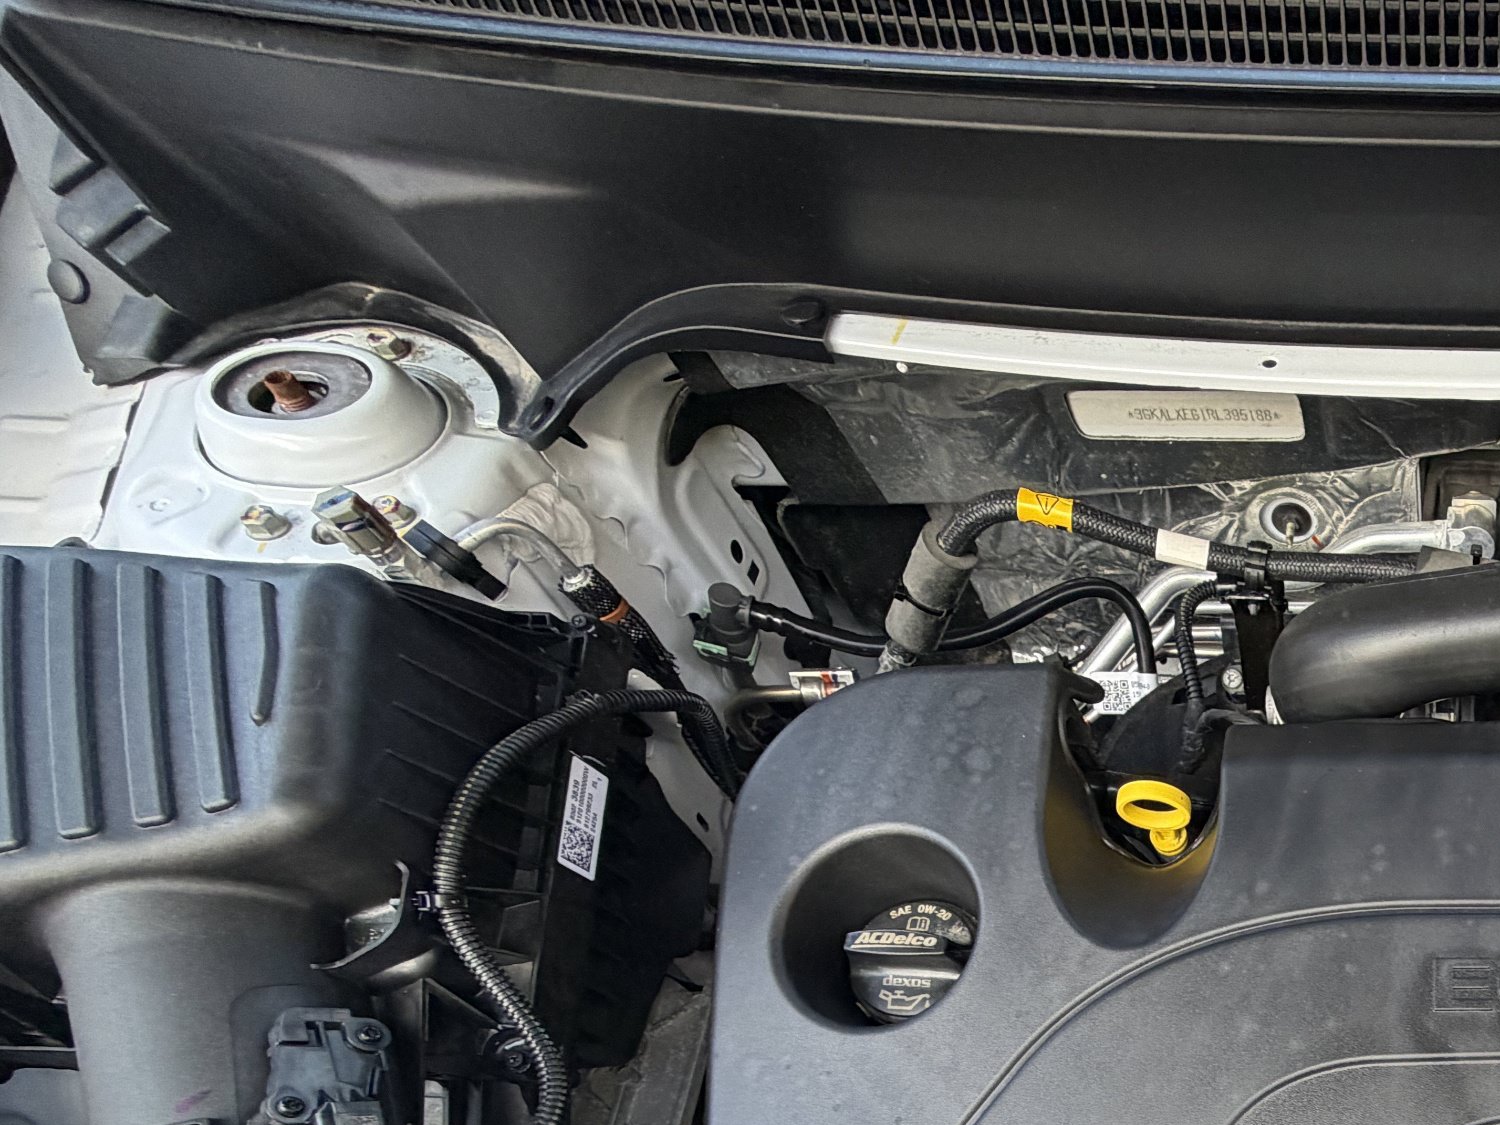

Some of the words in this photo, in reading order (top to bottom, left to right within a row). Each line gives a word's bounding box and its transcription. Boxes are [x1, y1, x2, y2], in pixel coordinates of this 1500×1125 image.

[889, 905, 912, 920] SAE
[917, 904, 952, 921] 0W-20
[854, 932, 938, 947] ACDelco
[882, 975, 932, 988] dexos
